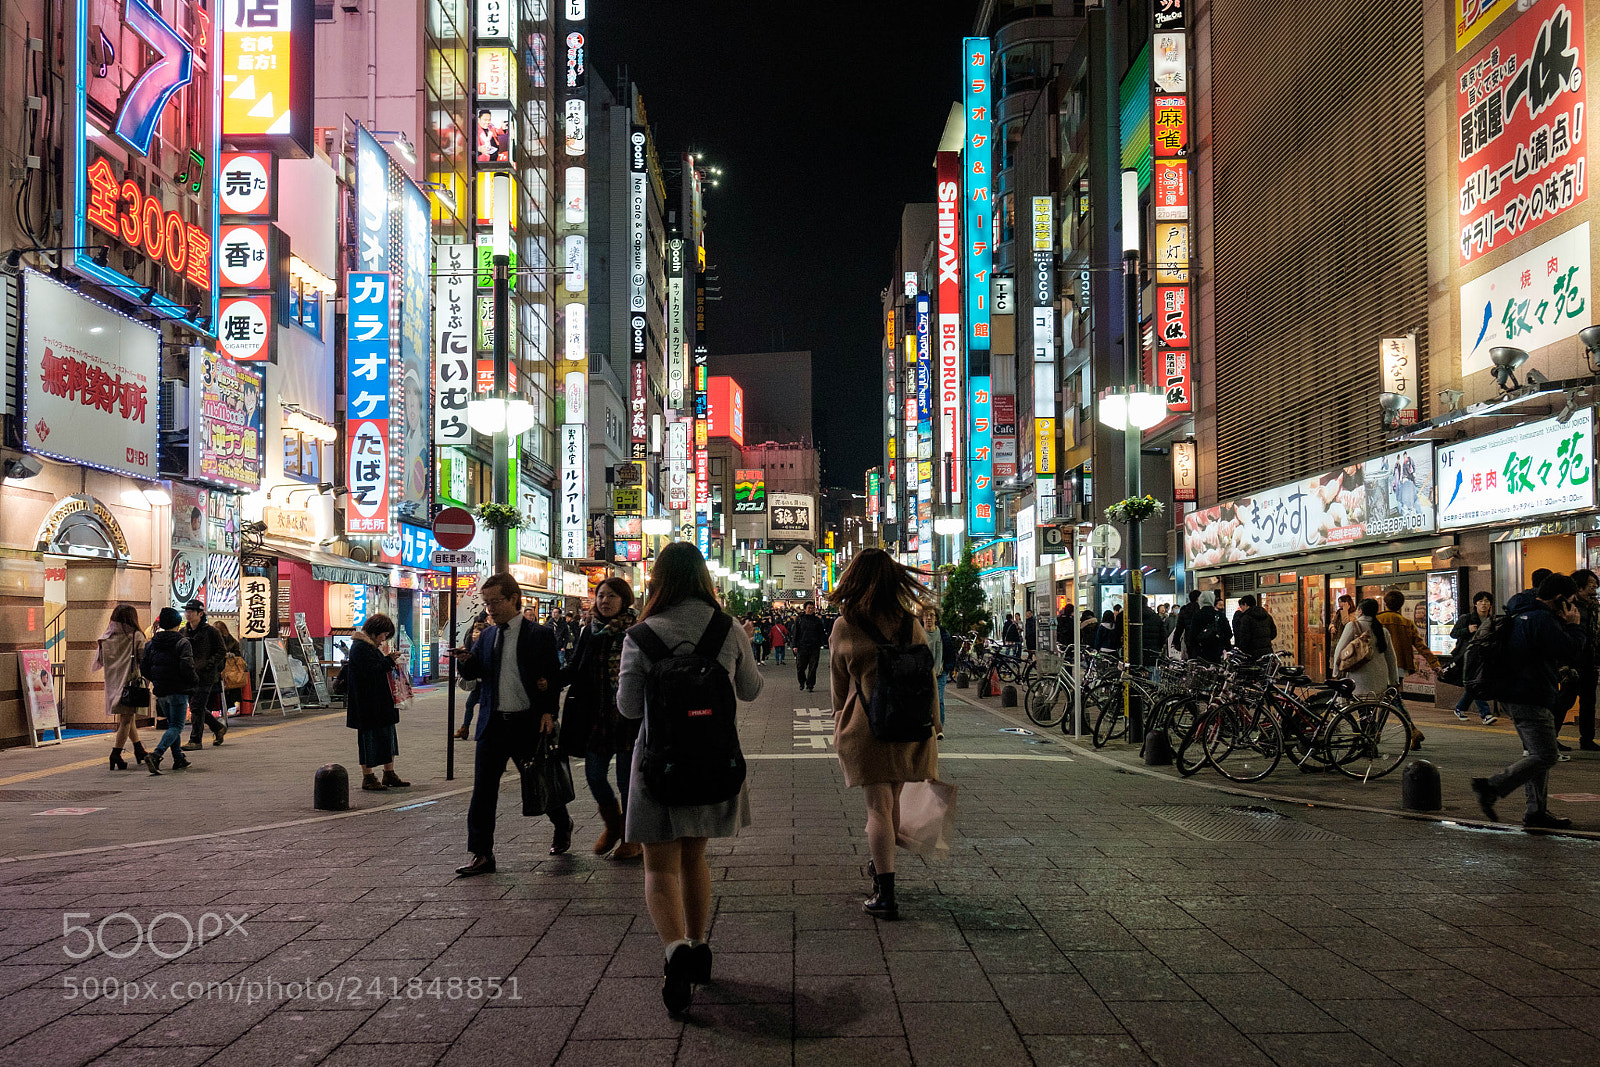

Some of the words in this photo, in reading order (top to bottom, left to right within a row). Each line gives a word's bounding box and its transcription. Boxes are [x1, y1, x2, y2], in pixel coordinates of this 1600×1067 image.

[1460, 46, 1500, 93] 東京で一番
[1468, 54, 1518, 106] 旨くて安い店
[1156, 108, 1184, 149] 麻雀
[1460, 86, 1504, 163] 居酒屋
[631, 132, 646, 169] Booth
[87, 156, 211, 291] 全300室
[938, 181, 958, 285] SHIDAX
[1520, 256, 1559, 289] 焼肉
[1501, 265, 1585, 339] 叙々苑
[352, 276, 386, 420] カラオケ
[631, 316, 646, 354] Booth
[942, 324, 956, 351] BIC
[40, 346, 148, 424] 無料案内所
[440, 331, 469, 438] にいむら
[942, 355, 957, 402] DRUG
[138, 453, 149, 467] B1
[356, 434, 381, 506] たばこ
[633, 451, 645, 459] 3F
[975, 389, 991, 519] カラオケ館
[1441, 450, 1455, 469] 9F
[1502, 431, 1590, 495] 叙々苑
[566, 470, 580, 525] ルノアール
[1471, 469, 1497, 493] 焼肉
[350, 518, 385, 532] 直売所
[435, 554, 472, 564] 自転車を除く
[246, 581, 266, 635] 和食酒処
